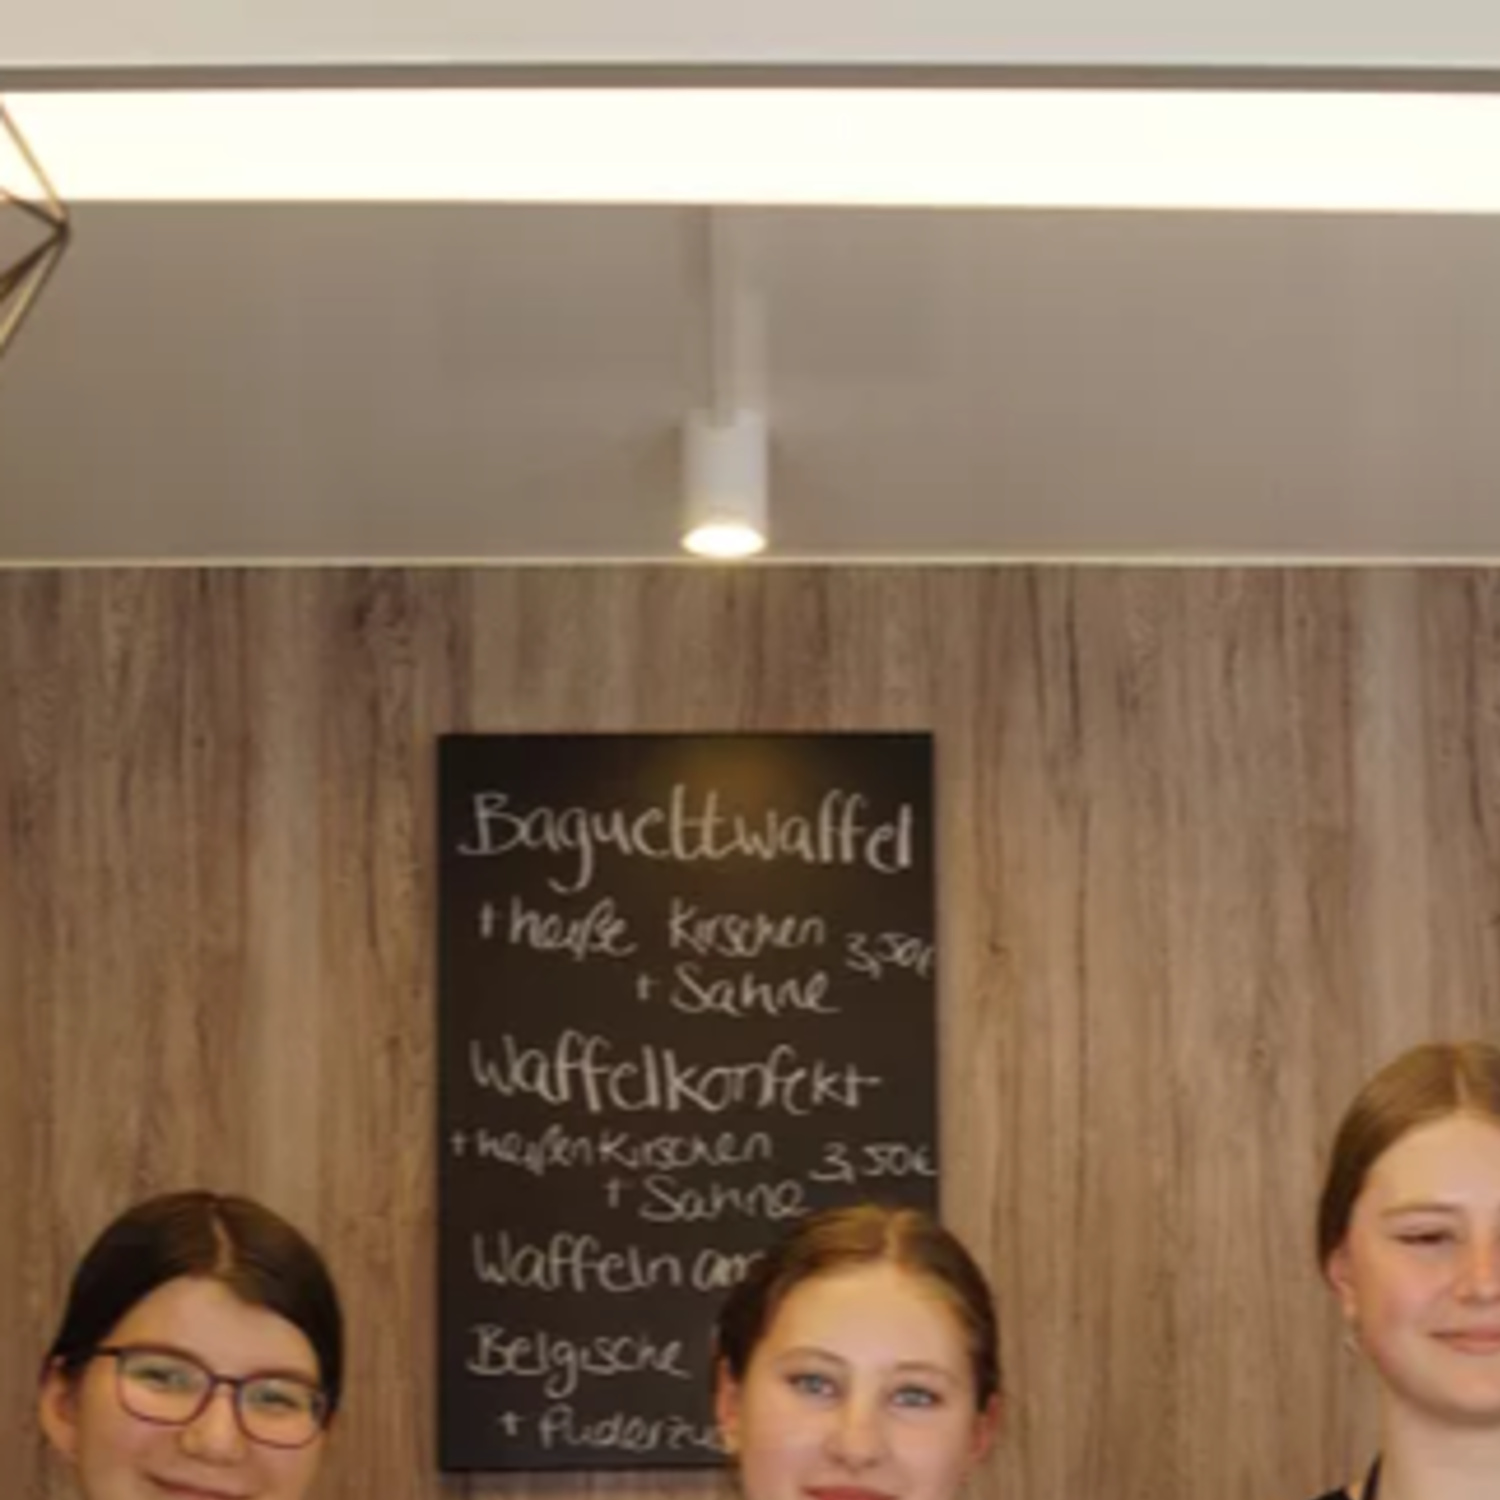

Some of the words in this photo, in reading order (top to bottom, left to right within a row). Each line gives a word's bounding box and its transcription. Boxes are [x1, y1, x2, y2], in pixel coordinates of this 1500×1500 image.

[671, 962, 842, 1016] Sahne
[470, 1030, 880, 1112] Waffelkonfekt
[638, 1174, 810, 1223] Sahne
[472, 1231, 682, 1292] Waffeln
[466, 1324, 691, 1398] Belgische
